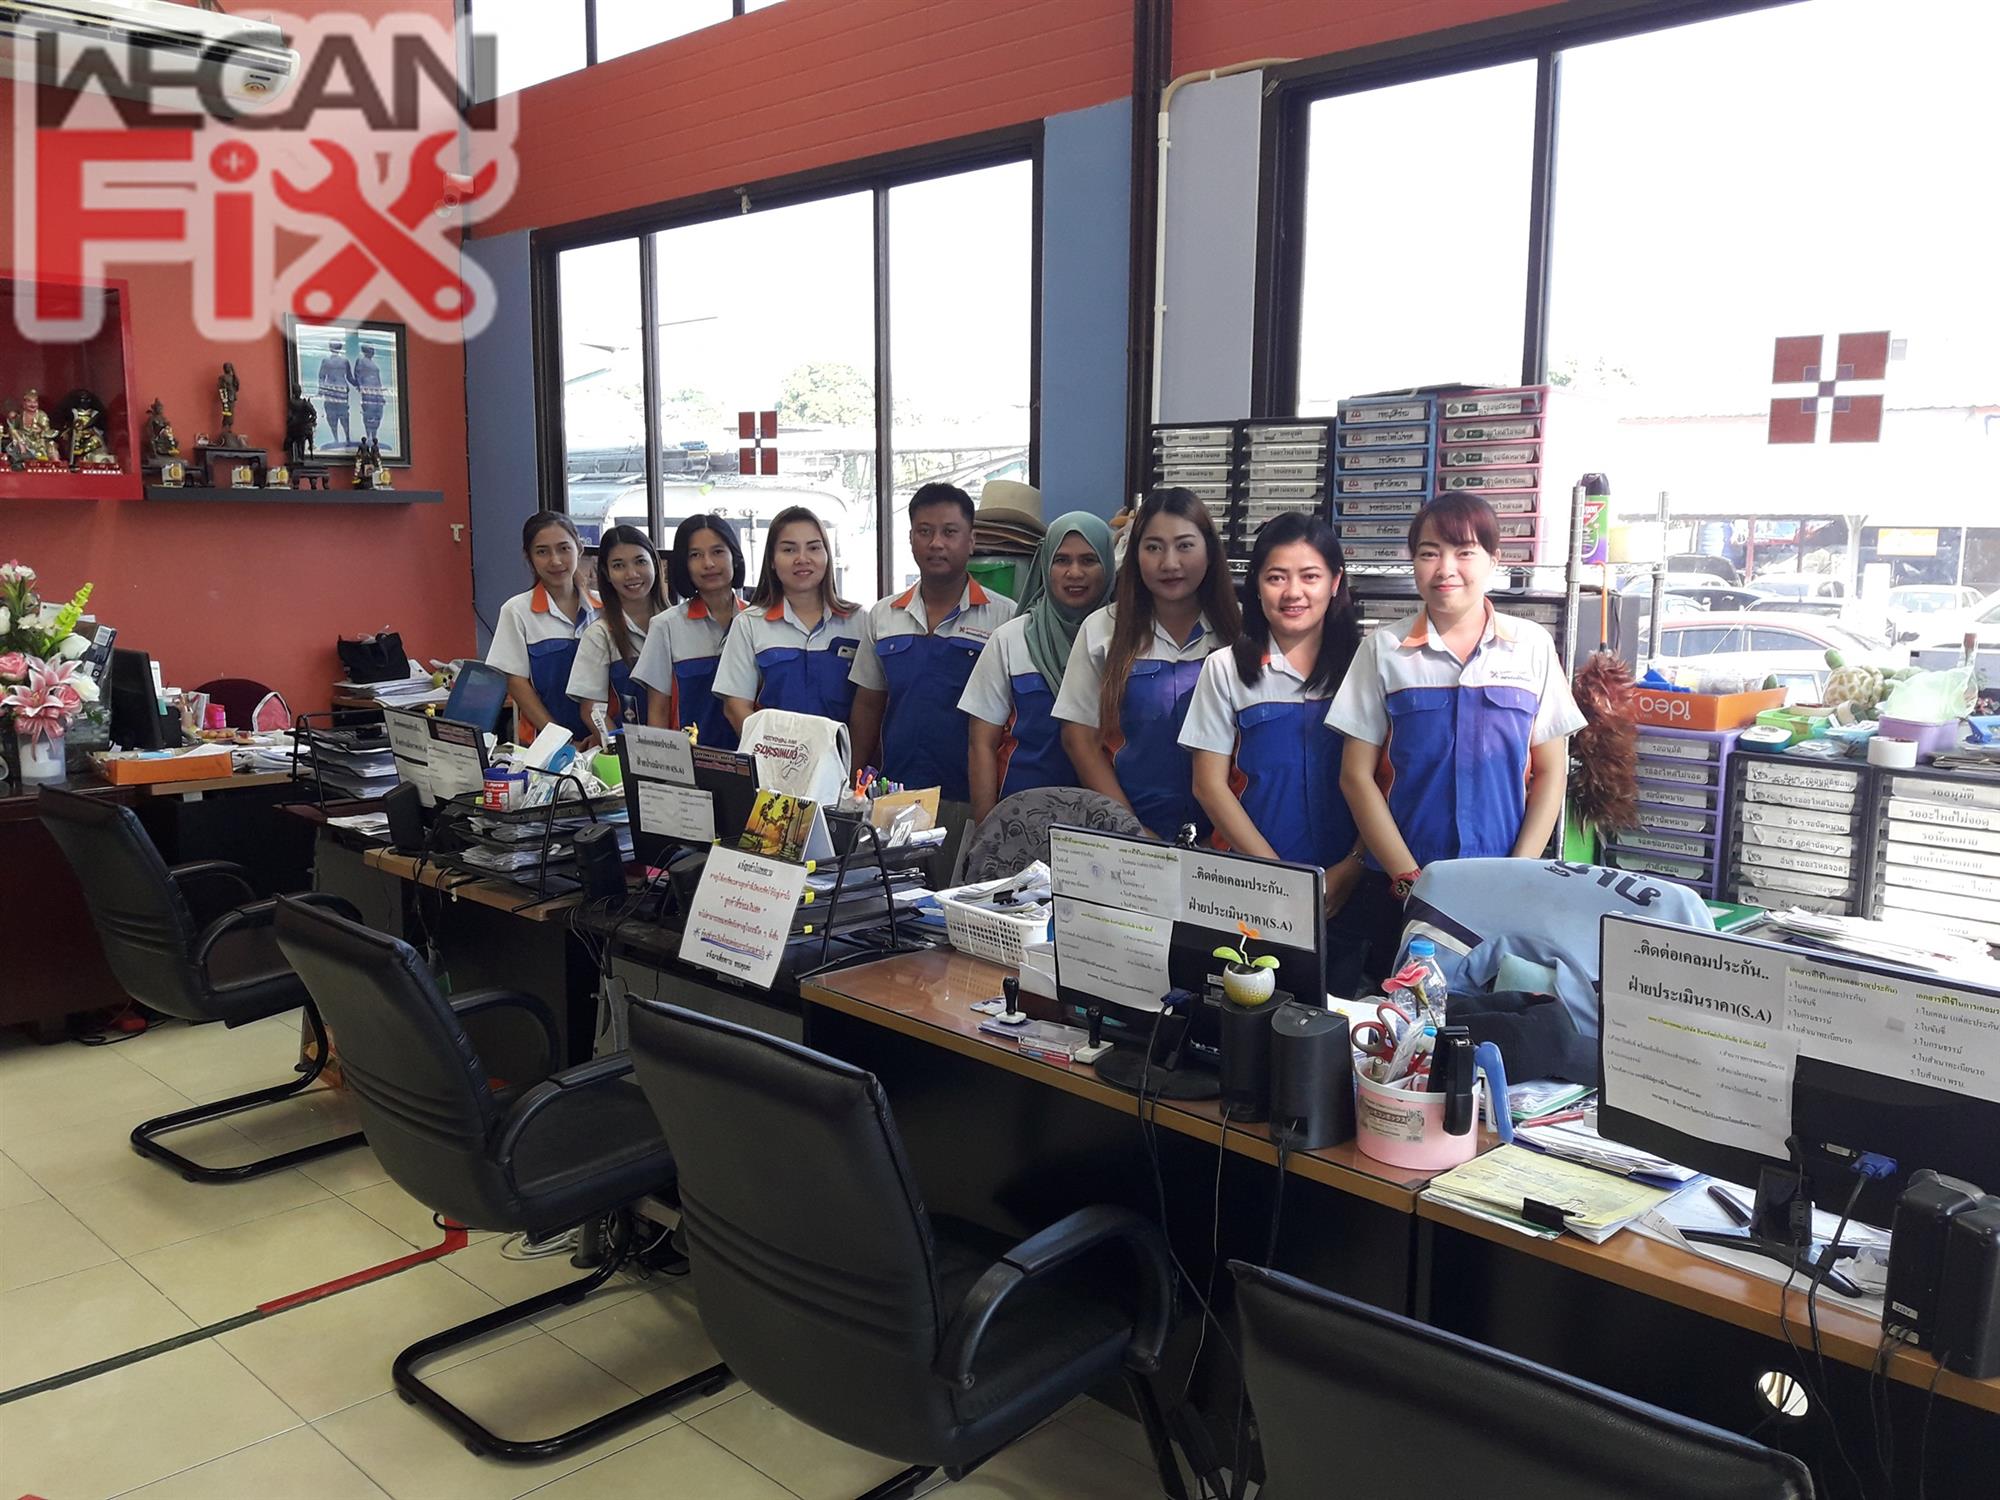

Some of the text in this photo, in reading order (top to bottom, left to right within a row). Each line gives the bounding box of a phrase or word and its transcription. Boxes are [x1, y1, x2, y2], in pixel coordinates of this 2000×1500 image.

[1639, 696, 1691, 722] idea
[1633, 939, 1769, 980] ..ติดต่อเคลมประกัน..
[1628, 975, 1772, 1024] ฝ่ายประเมินราคา(S.A)
